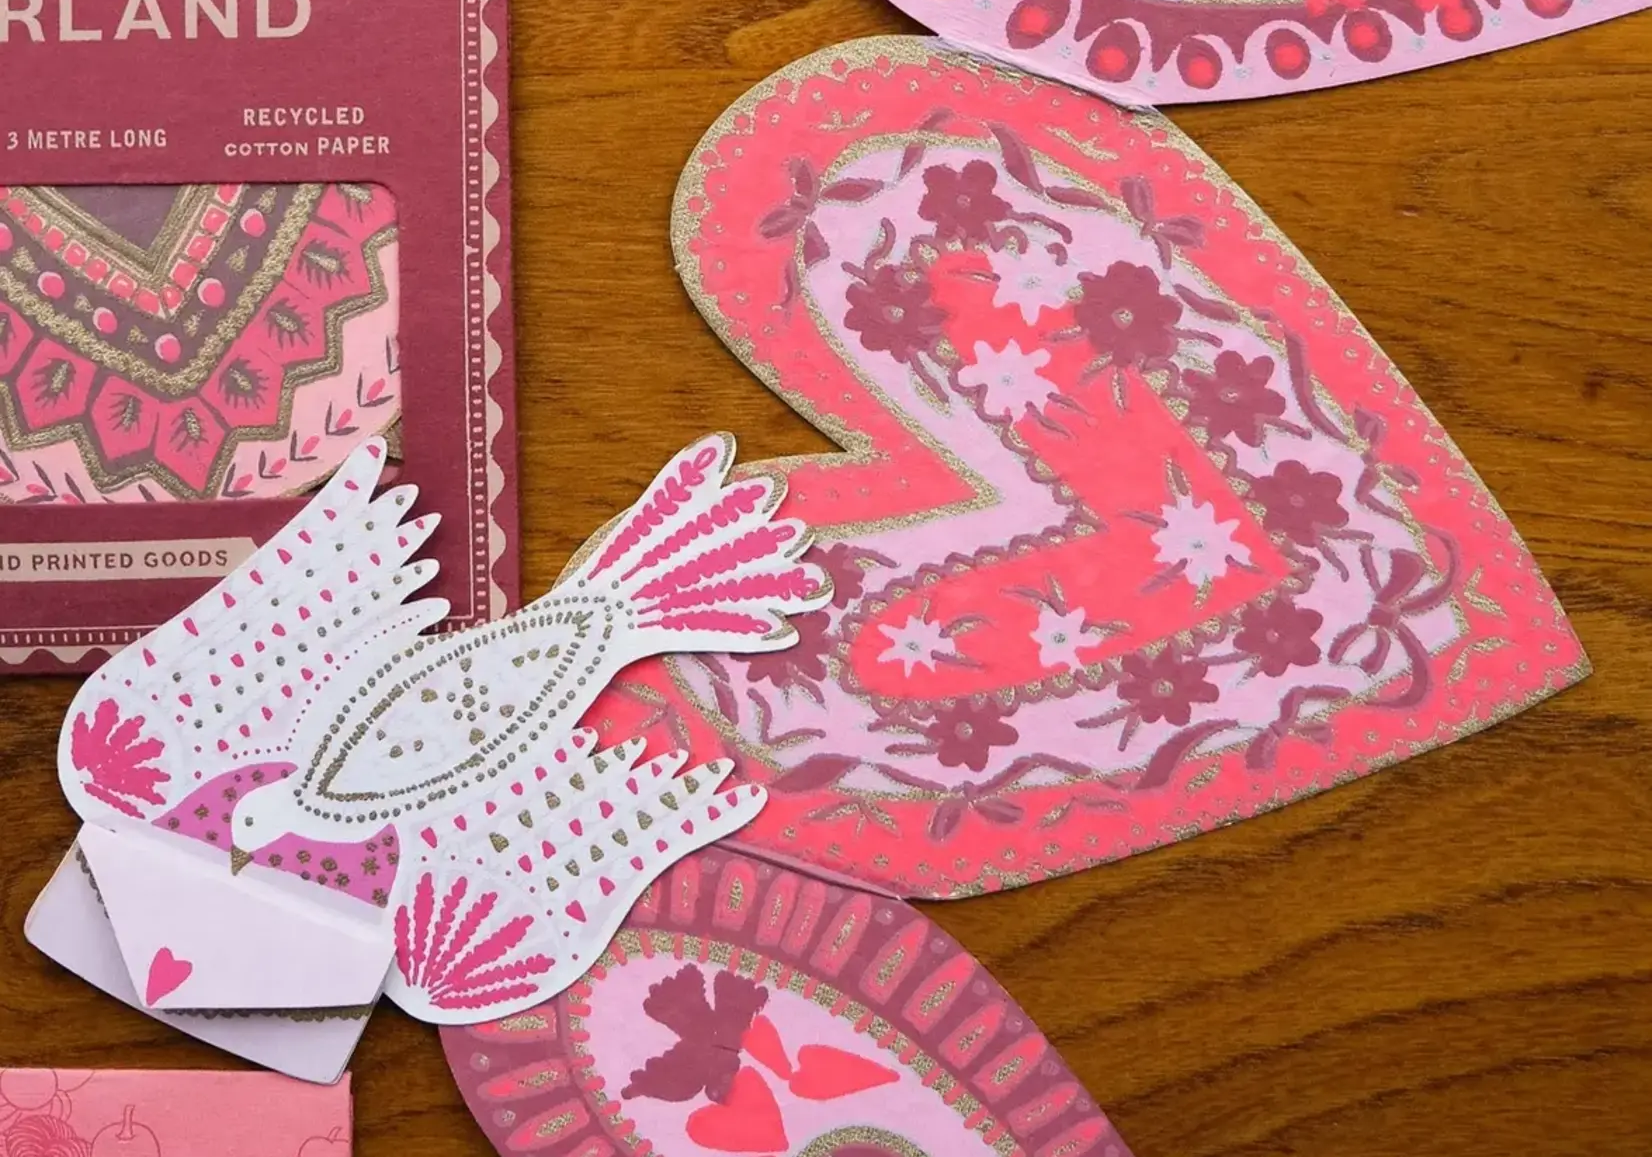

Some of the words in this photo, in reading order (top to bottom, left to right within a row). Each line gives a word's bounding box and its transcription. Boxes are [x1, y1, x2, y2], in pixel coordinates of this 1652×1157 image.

[243, 106, 365, 127] RECYCLED
[7, 131, 19, 150] 3
[27, 129, 101, 149] METRE
[110, 128, 167, 148] LONG
[224, 142, 309, 157] COTTON
[318, 136, 390, 155] PAPER
[32, 553, 134, 571] PRINTED
[144, 549, 228, 568] GOODS
